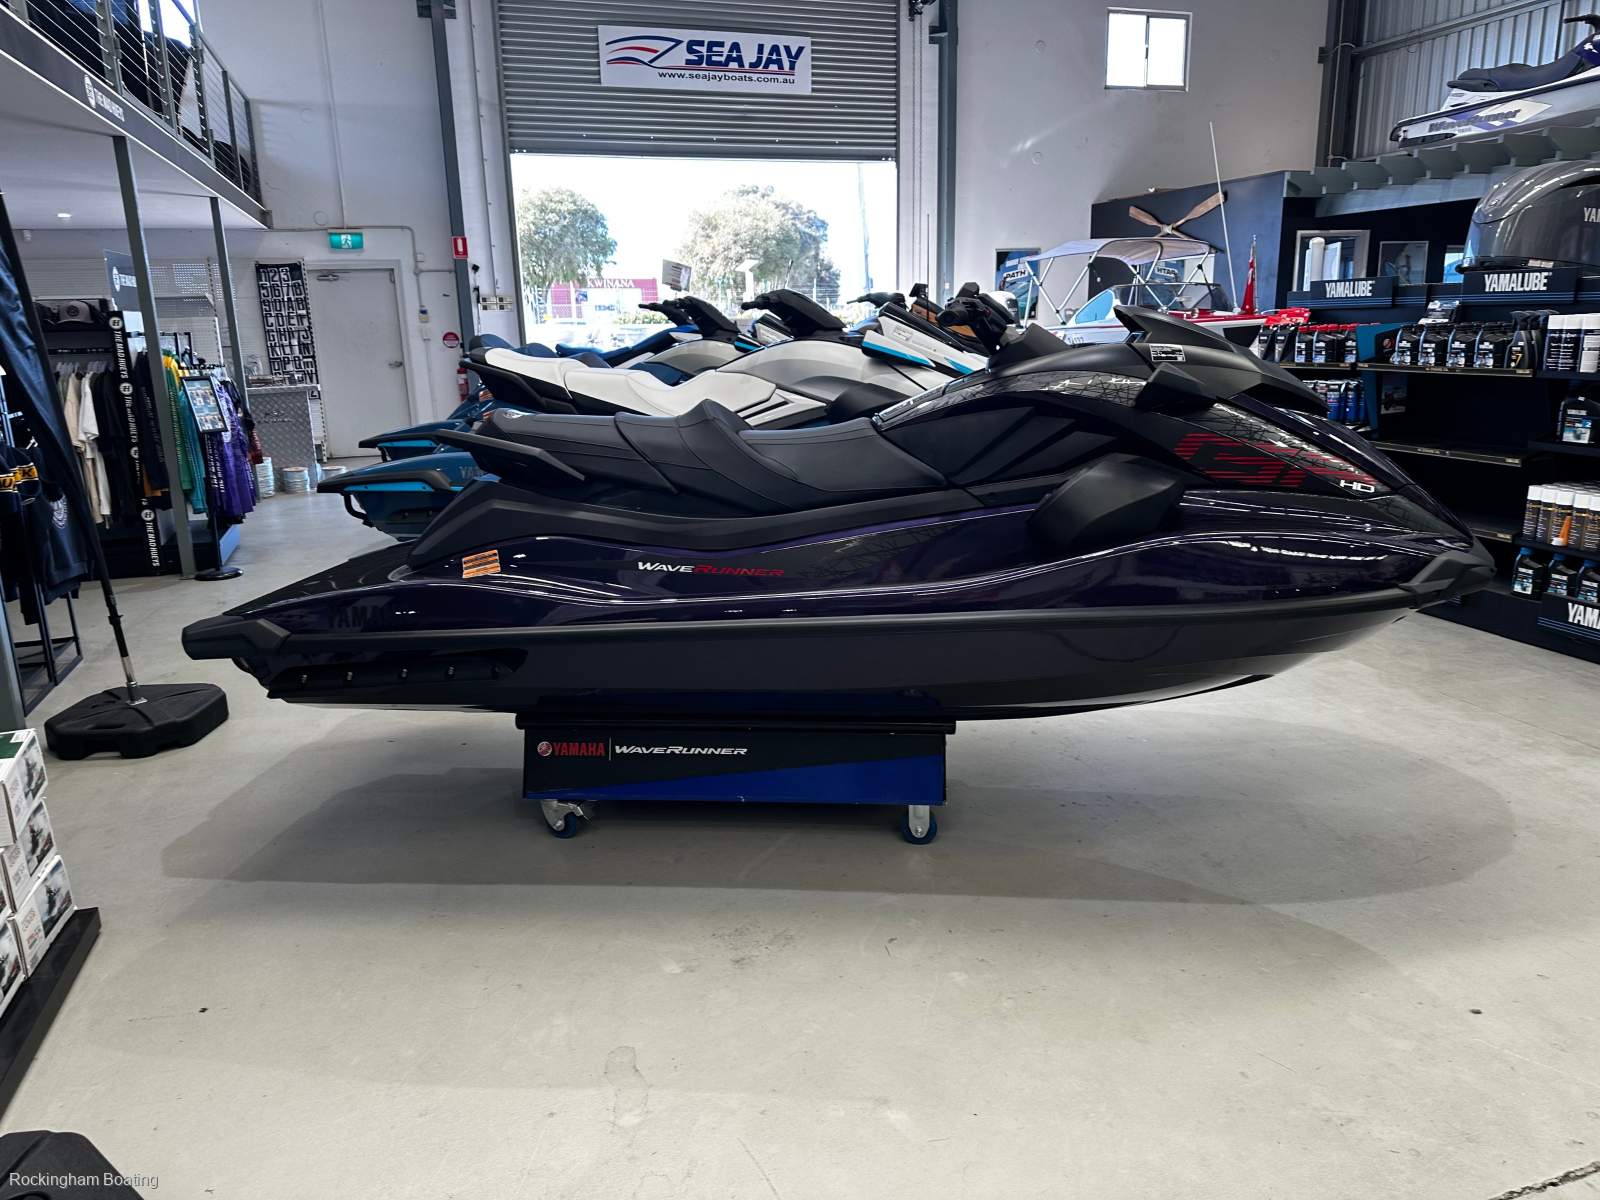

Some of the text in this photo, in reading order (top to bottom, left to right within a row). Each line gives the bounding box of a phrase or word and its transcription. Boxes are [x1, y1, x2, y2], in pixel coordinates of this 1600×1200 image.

[685, 39, 805, 71] SEA JAY
[657, 70, 795, 85] www.seajayboats.com.au
[586, 279, 635, 289] KWINANA
[1325, 281, 1374, 298] YAMALUBE
[1484, 271, 1549, 292] YAMALUBE
[145, 522, 160, 567] THE MAD HUEYS
[1567, 602, 1600, 630] YAM
[553, 742, 606, 756] YAMAHA
